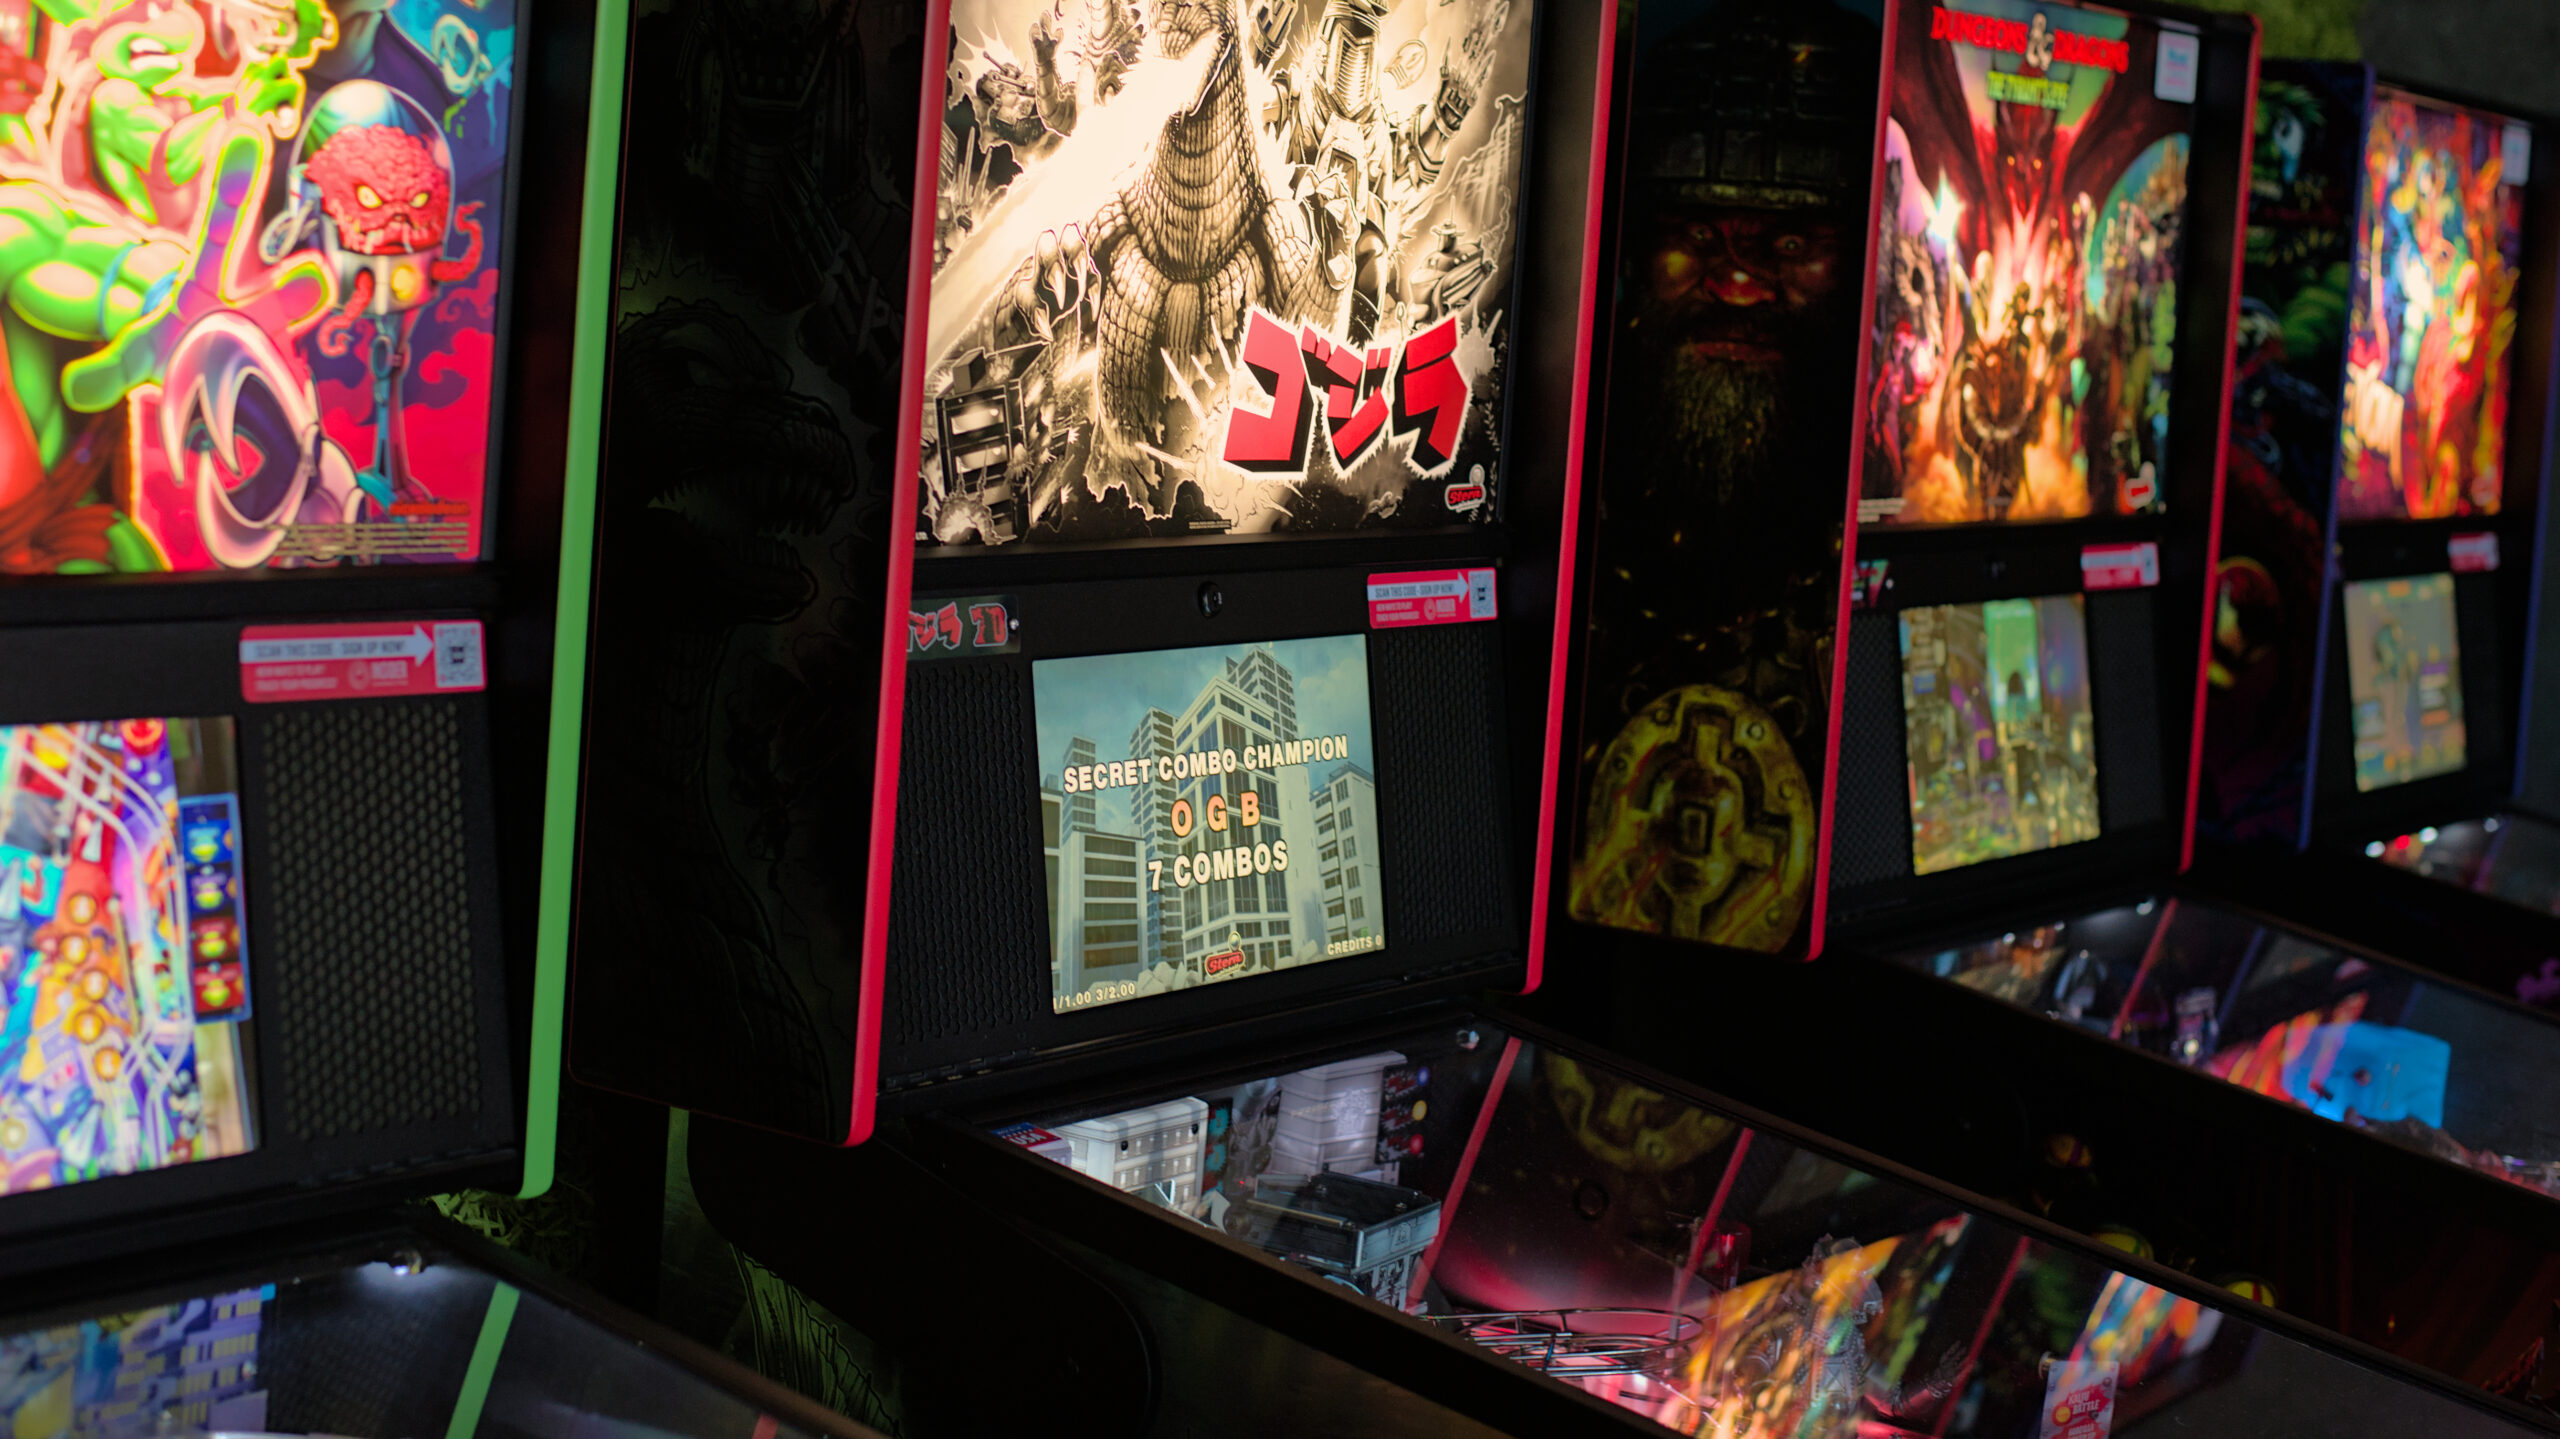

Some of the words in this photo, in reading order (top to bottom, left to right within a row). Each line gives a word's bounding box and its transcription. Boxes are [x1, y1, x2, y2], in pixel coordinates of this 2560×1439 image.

[1930, 6, 2028, 54] DUNGEONS
[2026, 13, 2054, 71] &
[2053, 28, 2130, 74] DRAGONS
[1222, 309, 1469, 473] ゴジラ
[907, 602, 962, 652] ジラ
[1063, 757, 1152, 794] SECRET
[1158, 748, 1237, 781] COMBO
[1243, 734, 1349, 771] CHAMPION
[1148, 859, 1164, 892] 7
[1173, 839, 1289, 888] COMBOS
[1206, 951, 1243, 974] Stern
[1327, 936, 1373, 956] CREDITS
[1095, 982, 1136, 1002] 3/2.00
[2072, 1399, 2100, 1415] BATTLE
